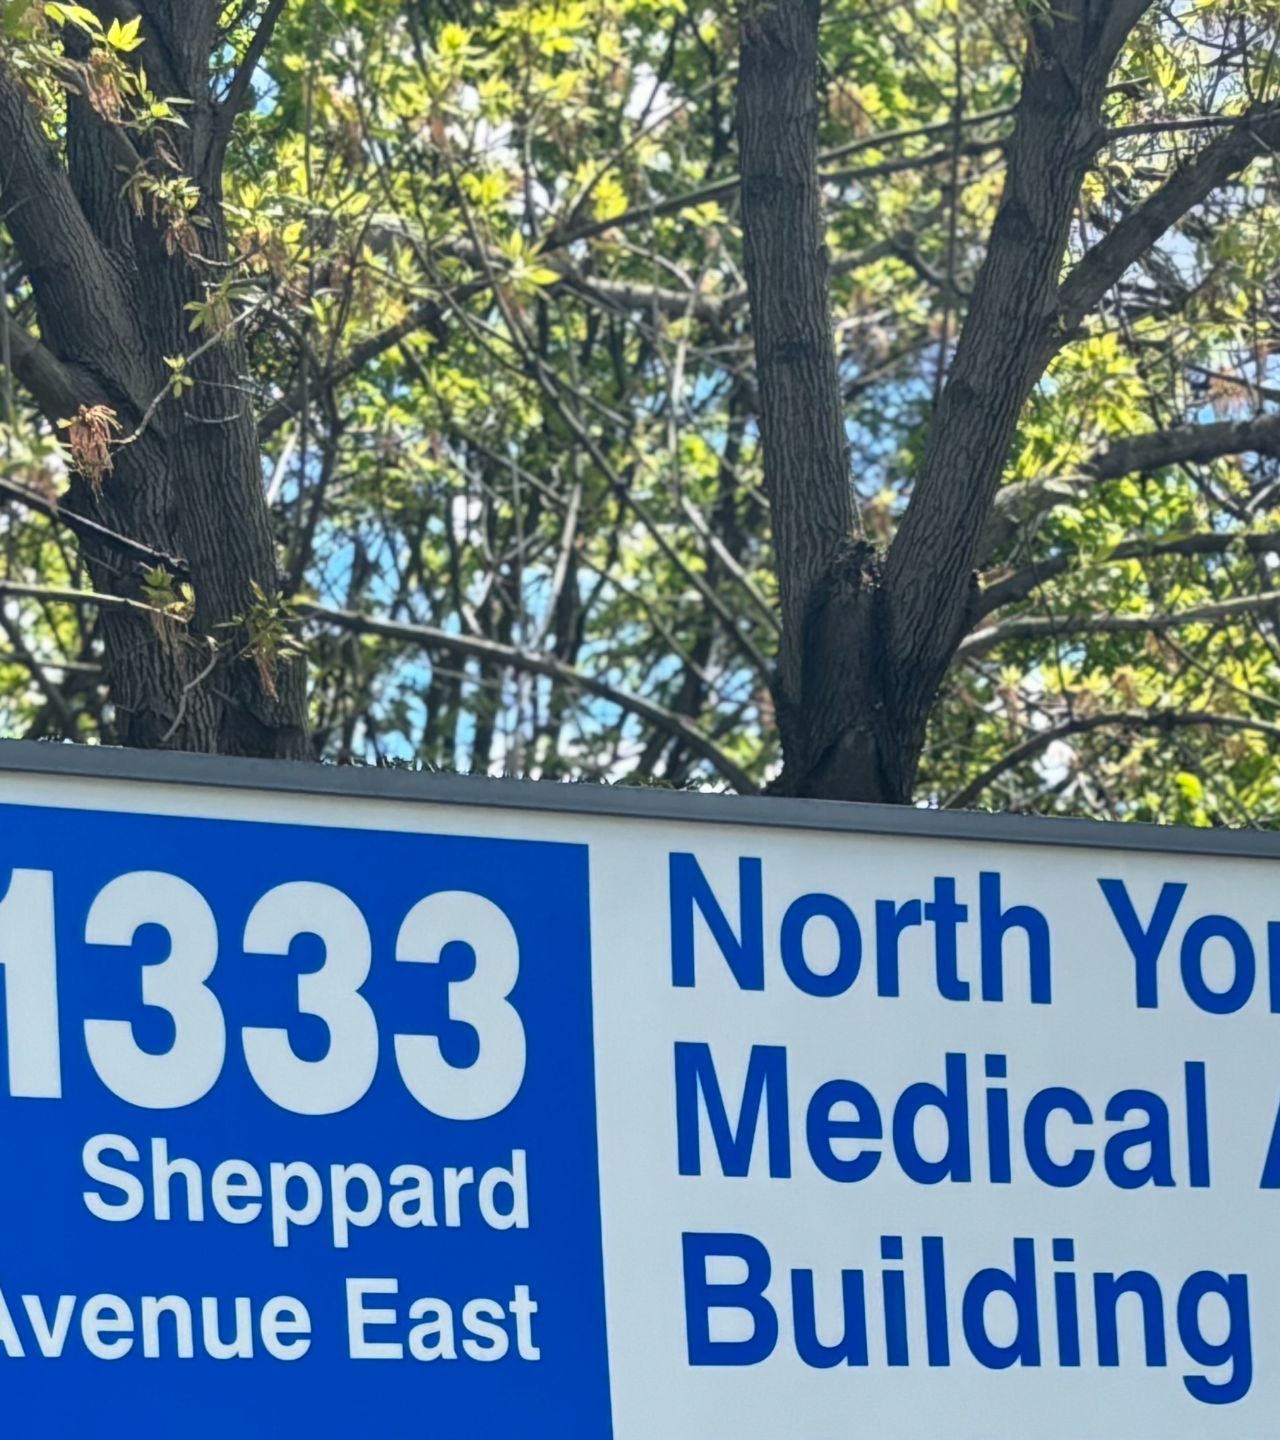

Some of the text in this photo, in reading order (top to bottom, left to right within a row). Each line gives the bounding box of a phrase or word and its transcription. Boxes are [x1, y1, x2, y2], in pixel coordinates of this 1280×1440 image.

[668, 850, 1053, 1006] North
[81, 1133, 530, 1249] Sheppard
[672, 1040, 1212, 1191] Medical
[345, 1277, 541, 1362] East
[680, 1231, 1255, 1406] Building
